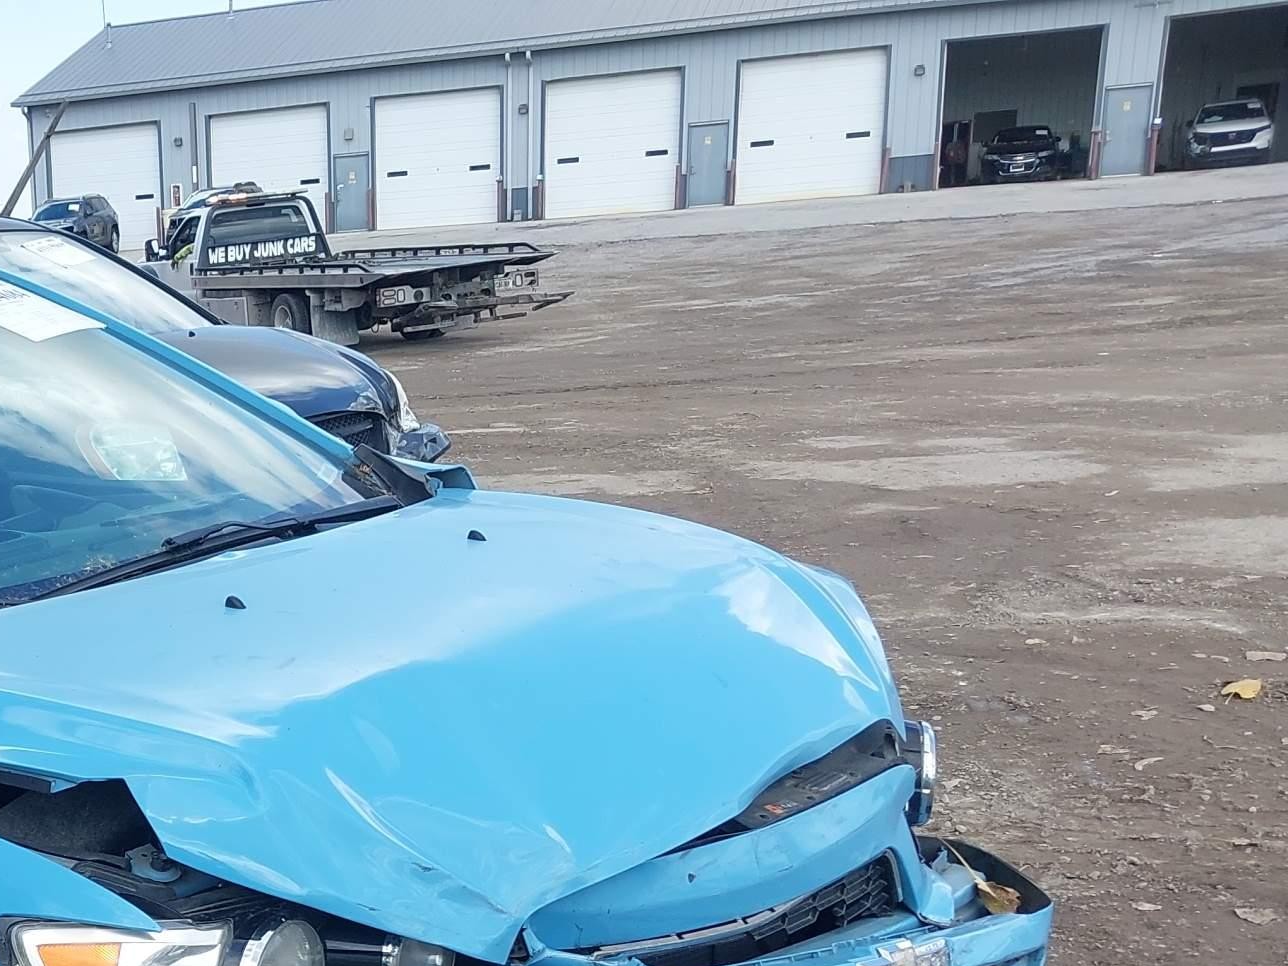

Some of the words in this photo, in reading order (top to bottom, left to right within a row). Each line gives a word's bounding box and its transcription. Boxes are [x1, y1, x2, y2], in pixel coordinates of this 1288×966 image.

[208, 246, 226, 265] WE
[227, 243, 252, 263] BUY
[253, 239, 285, 258] JUNK
[286, 235, 316, 255] CARS
